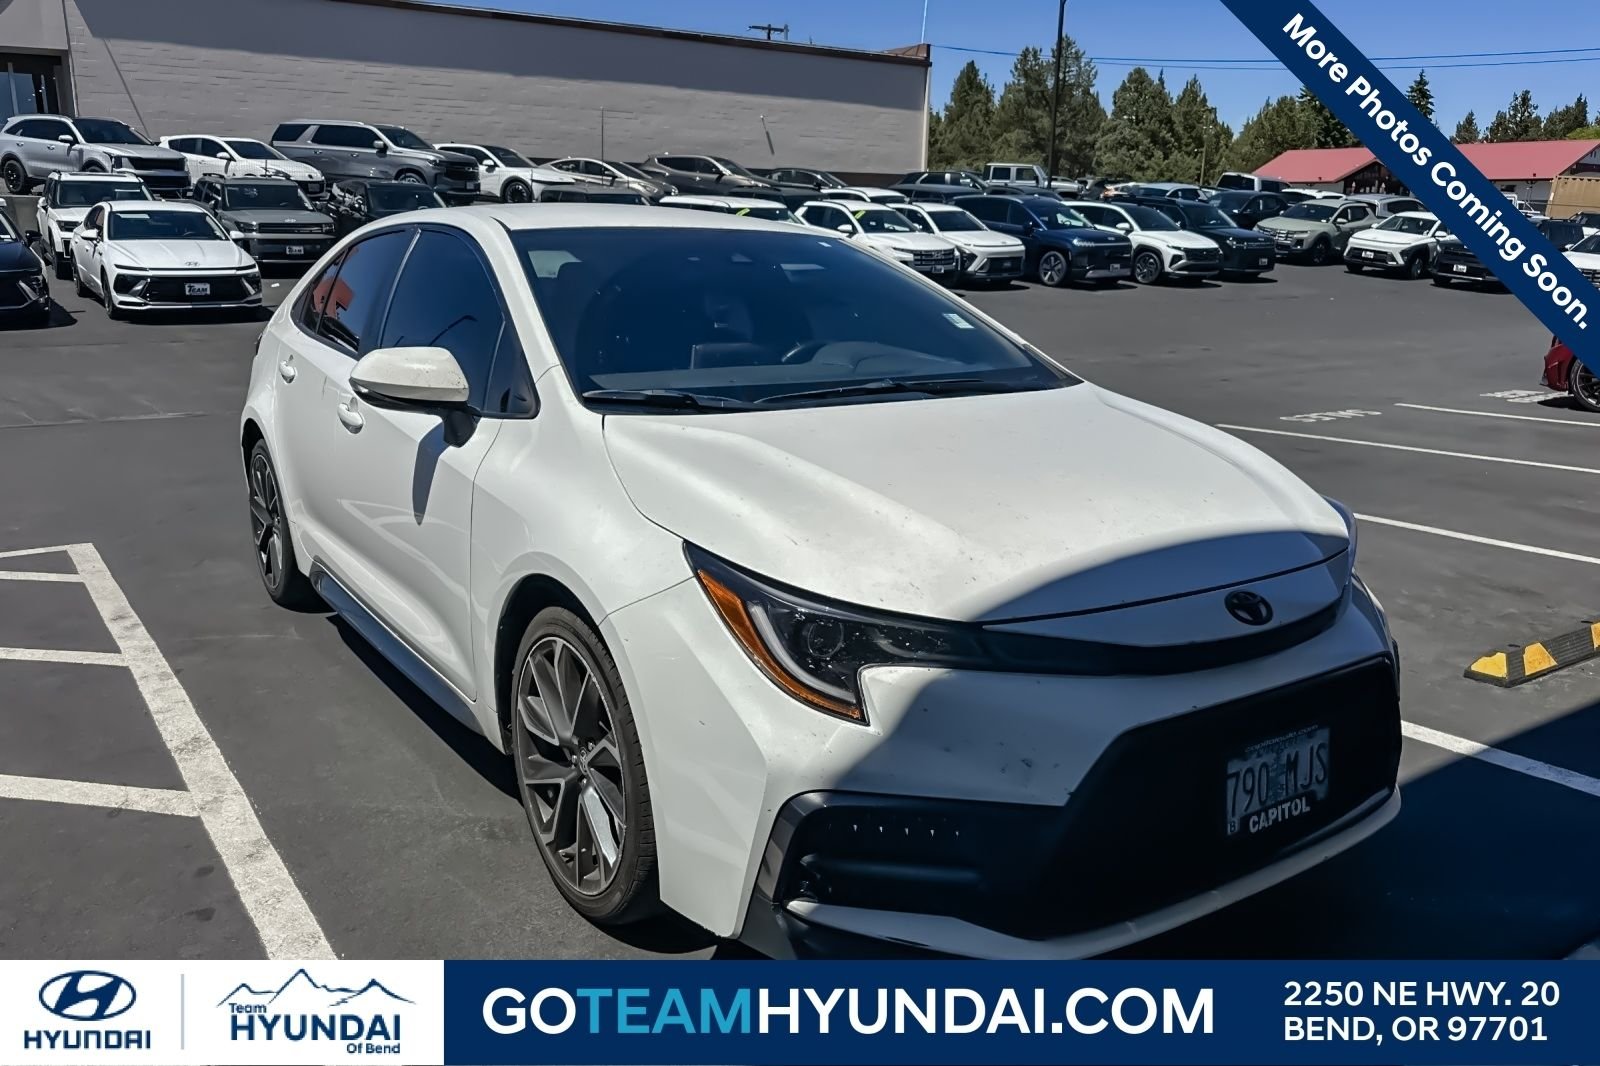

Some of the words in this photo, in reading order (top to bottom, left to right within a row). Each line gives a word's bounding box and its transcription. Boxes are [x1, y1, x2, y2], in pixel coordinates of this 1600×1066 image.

[1226, 761, 1269, 819] 790
[1285, 742, 1328, 797] MJS
[1249, 796, 1311, 834] CAPITOL
